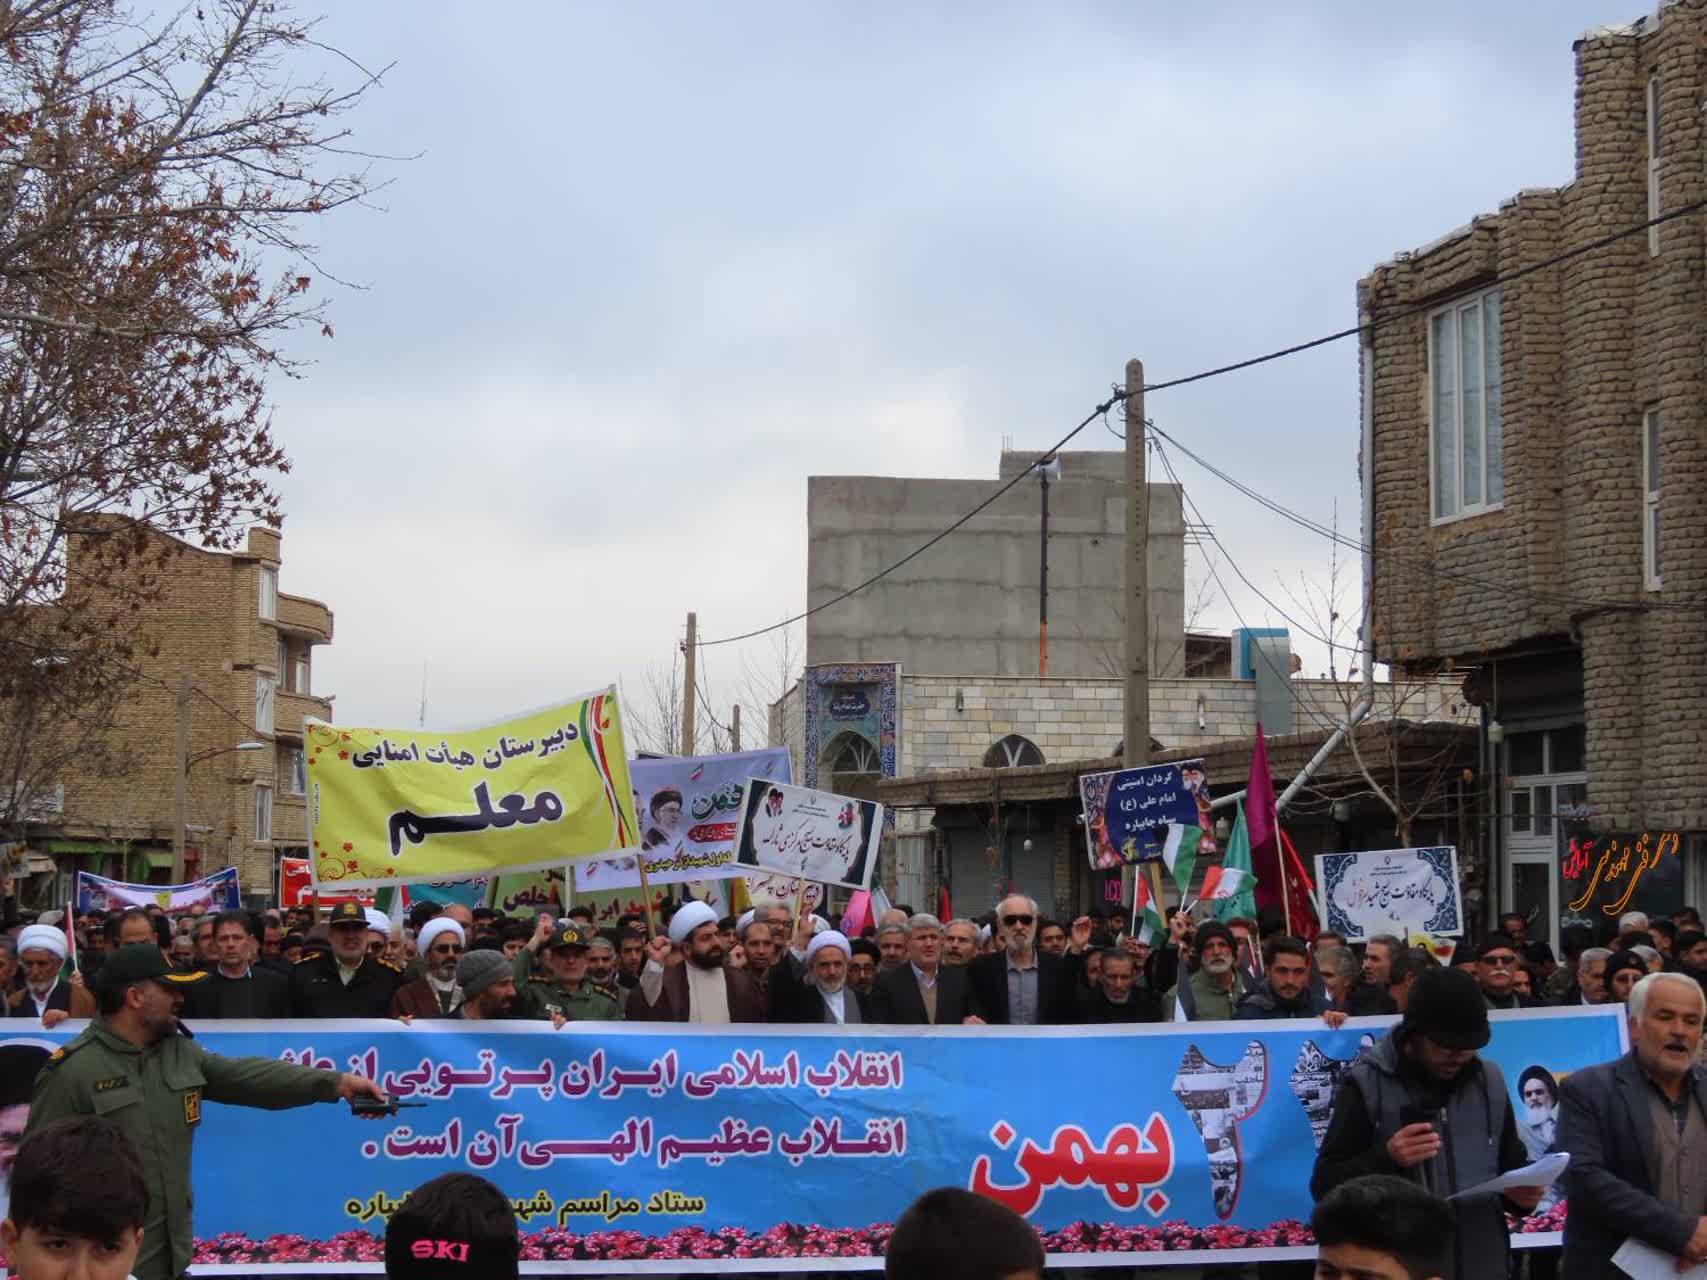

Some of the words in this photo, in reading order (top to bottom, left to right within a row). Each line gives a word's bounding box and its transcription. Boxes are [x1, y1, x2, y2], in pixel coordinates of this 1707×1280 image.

[352, 739, 419, 768] امنایی
[424, 741, 475, 771] هیأت
[483, 720, 579, 769] دبیرستان
[1117, 776, 1145, 792] امنیتی
[1119, 798, 1137, 812] (ع)
[1139, 795, 1158, 809] علی
[1159, 791, 1177, 807] امام
[388, 780, 564, 857] معلم
[562, 1050, 677, 1097] ایران
[684, 1050, 799, 1096] اسلامی
[807, 1050, 902, 1096] انقلاب
[385, 1118, 460, 1157] است
[467, 1115, 521, 1168] آن
[520, 1117, 653, 1165] الهی
[659, 1117, 772, 1167] عظیم
[780, 1117, 906, 1164] انقلاب
[969, 1112, 1175, 1218] بهمن
[559, 1192, 640, 1224] مراسم
[647, 1192, 704, 1214] ستاد
[411, 1239, 470, 1262] SKI
